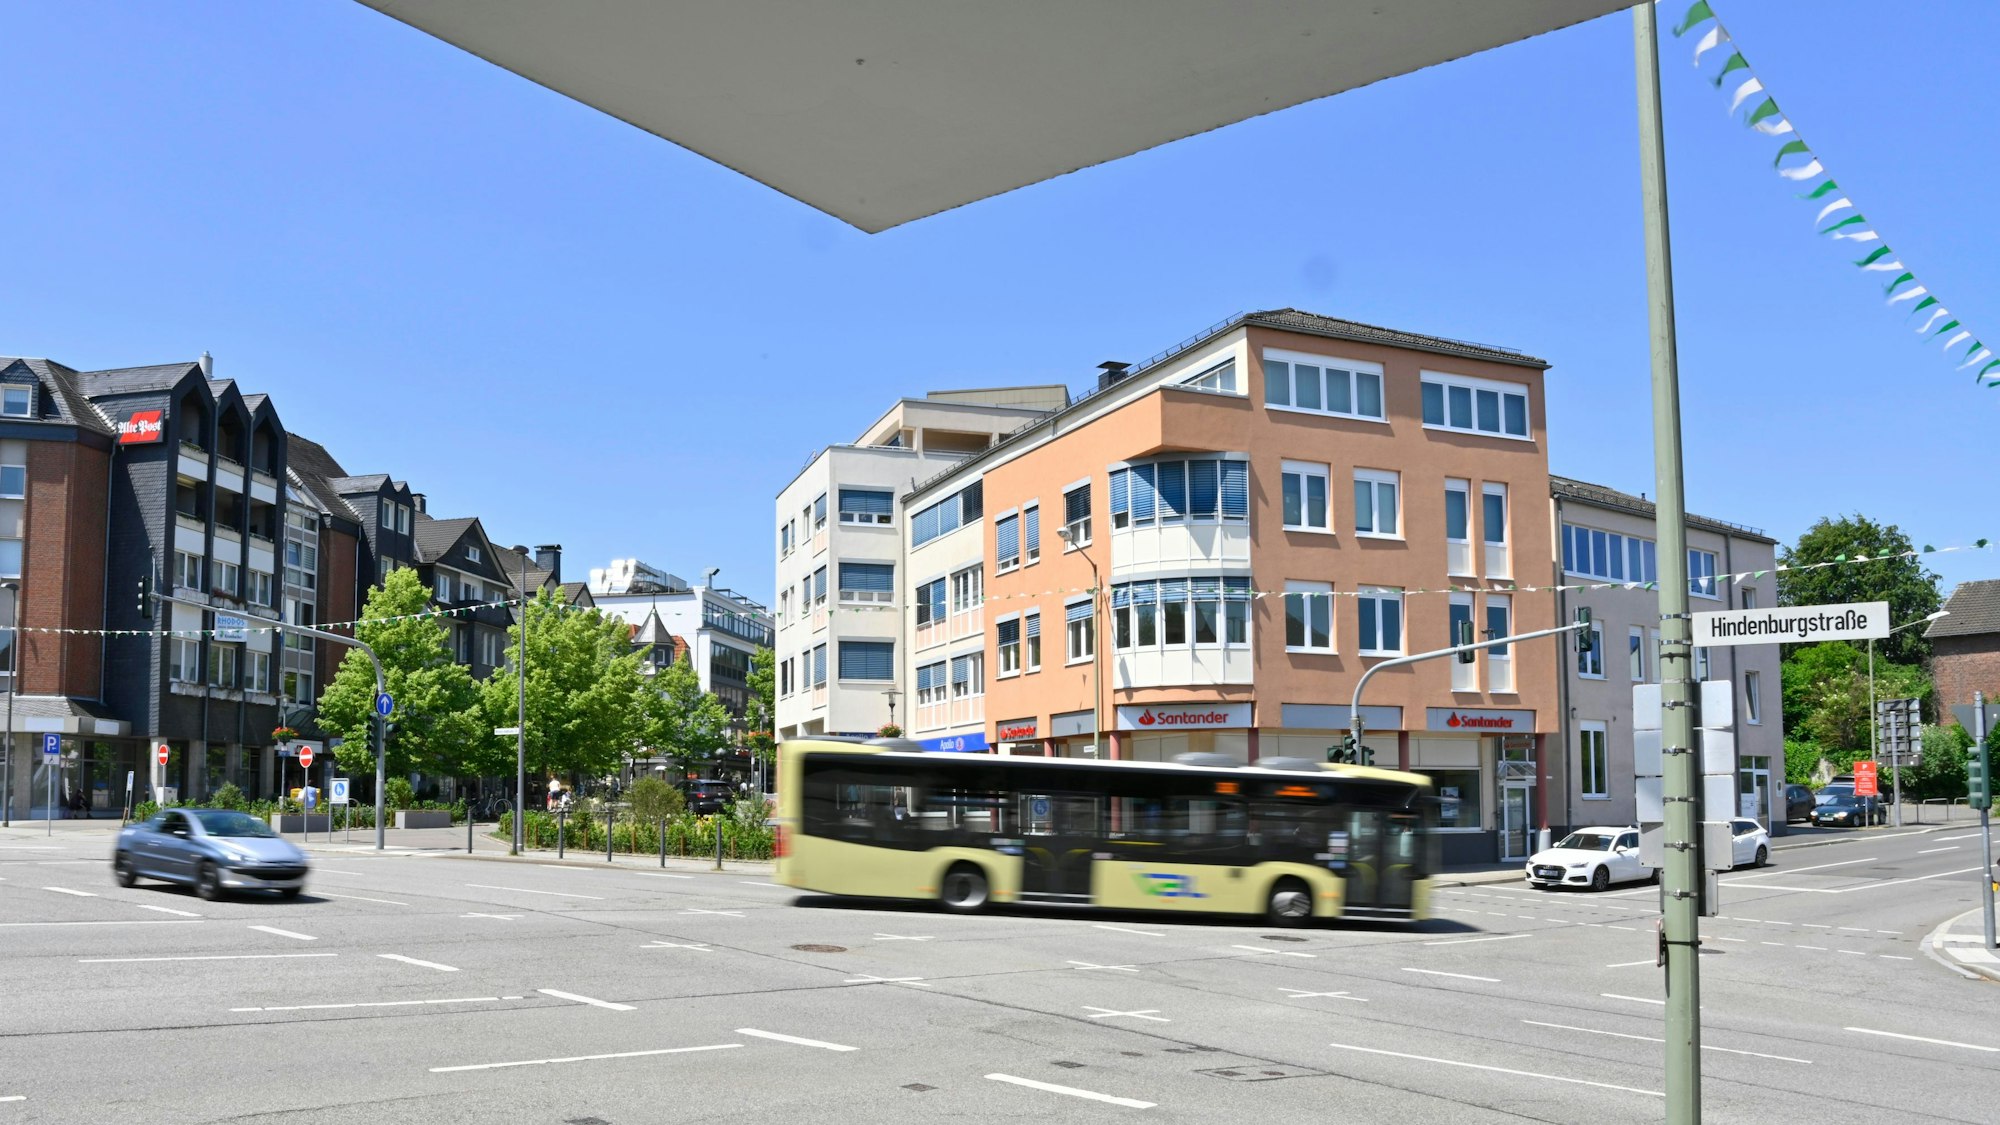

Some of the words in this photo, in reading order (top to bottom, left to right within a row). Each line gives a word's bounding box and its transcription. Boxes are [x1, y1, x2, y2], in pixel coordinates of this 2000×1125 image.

[118, 421, 138, 433] Alte
[138, 420, 161, 436] Post
[217, 616, 245, 626] RHODOS
[1711, 609, 1868, 638] Hindenburgstraße
[1157, 711, 1229, 725] Santander
[1461, 715, 1514, 728] Santander
[1007, 724, 1036, 740] Santander
[47, 736, 57, 751] P
[940, 738, 955, 751] Apollo
